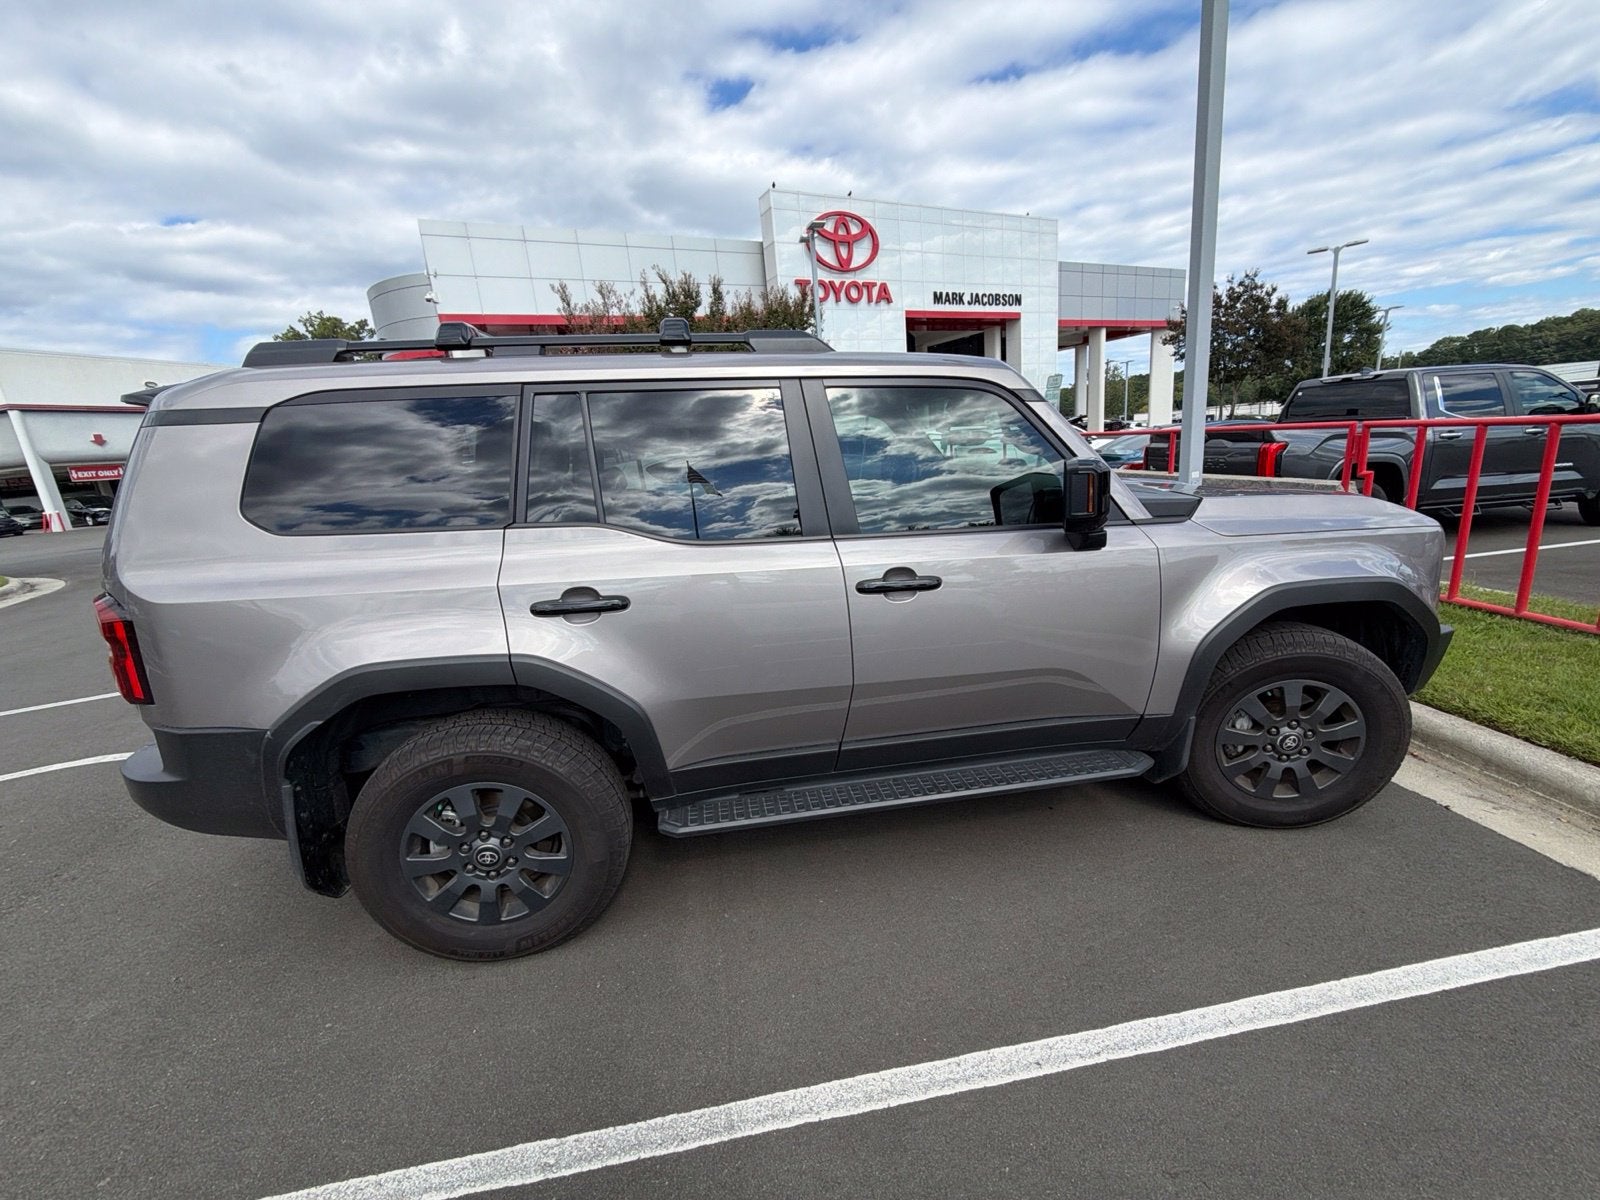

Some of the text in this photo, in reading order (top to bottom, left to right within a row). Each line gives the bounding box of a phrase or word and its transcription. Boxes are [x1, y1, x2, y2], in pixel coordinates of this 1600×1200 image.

[794, 279, 893, 304] TOYOTA
[933, 291, 1022, 307] MARK JACOBSON
[98, 469, 118, 477] ONLY
